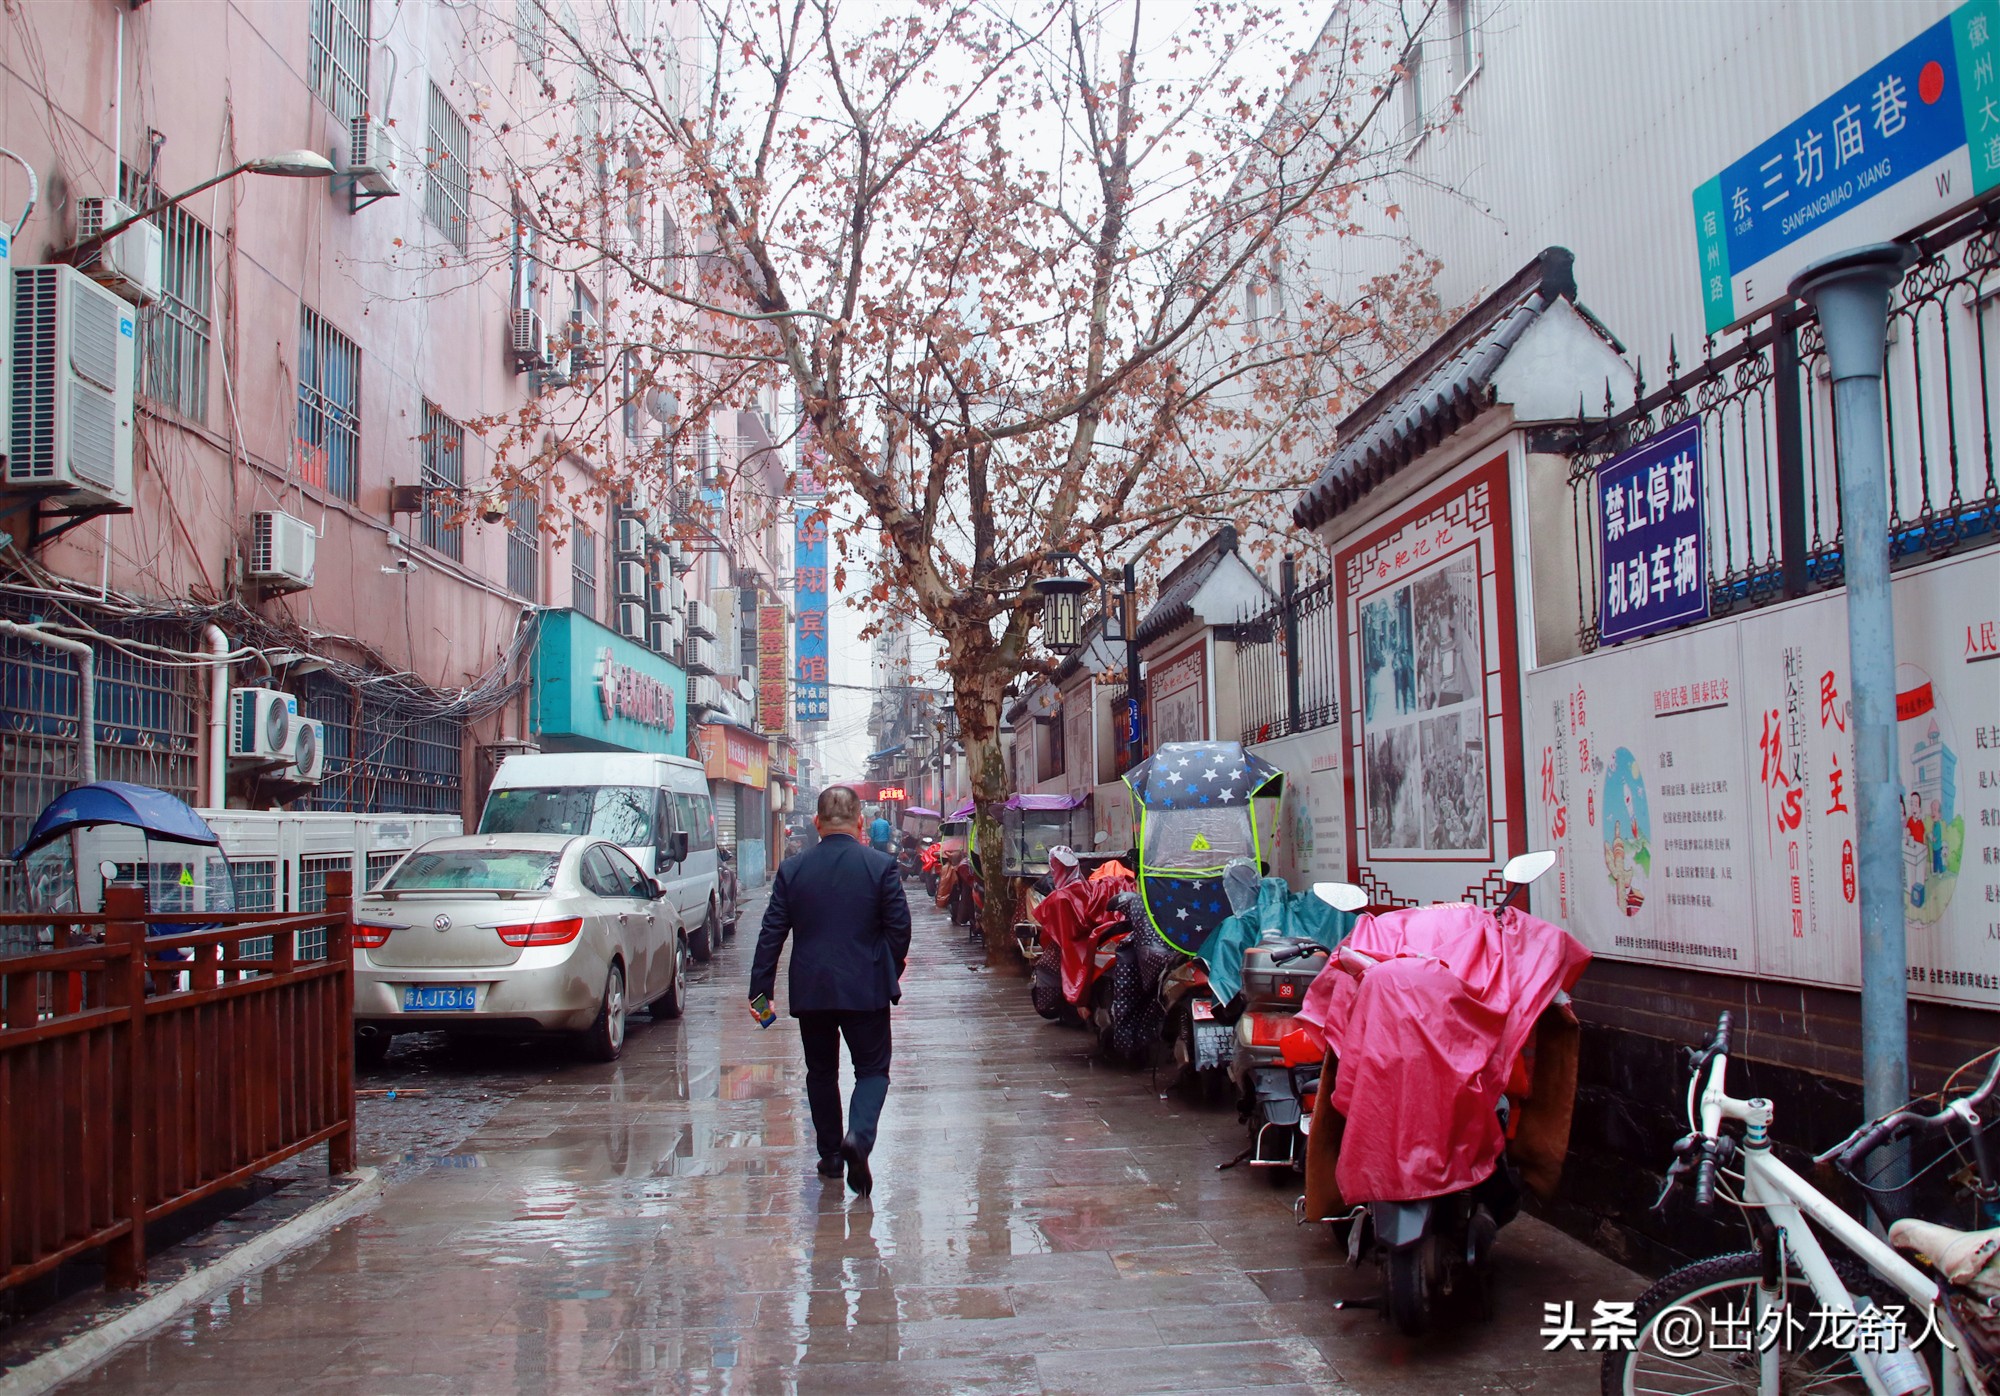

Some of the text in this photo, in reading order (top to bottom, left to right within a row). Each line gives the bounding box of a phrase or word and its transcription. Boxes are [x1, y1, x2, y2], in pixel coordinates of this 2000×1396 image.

[1968, 12, 2000, 172] 徽州大道
[1759, 75, 1907, 212] 三坊庙巷
[1731, 186, 1751, 222] 东
[1781, 158, 1891, 235] SANFANGMIAO XIANG
[1936, 169, 1950, 198] W
[1703, 211, 1723, 302] 宿州路
[1745, 279, 1754, 301] E
[1605, 451, 1695, 542] 禁止停放
[1376, 529, 1453, 578] 合肥记忆
[1608, 534, 1697, 618] 机动车辆
[796, 526, 826, 682] 中翔宾馆
[1964, 621, 2000, 656] 人民
[797, 687, 828, 699] 钟点房
[797, 702, 828, 714] 特价房
[1784, 647, 1801, 783] 社会主义
[1820, 670, 1846, 816] 民主
[1979, 770, 2000, 789] 是人
[1281, 985, 1292, 995] 39
